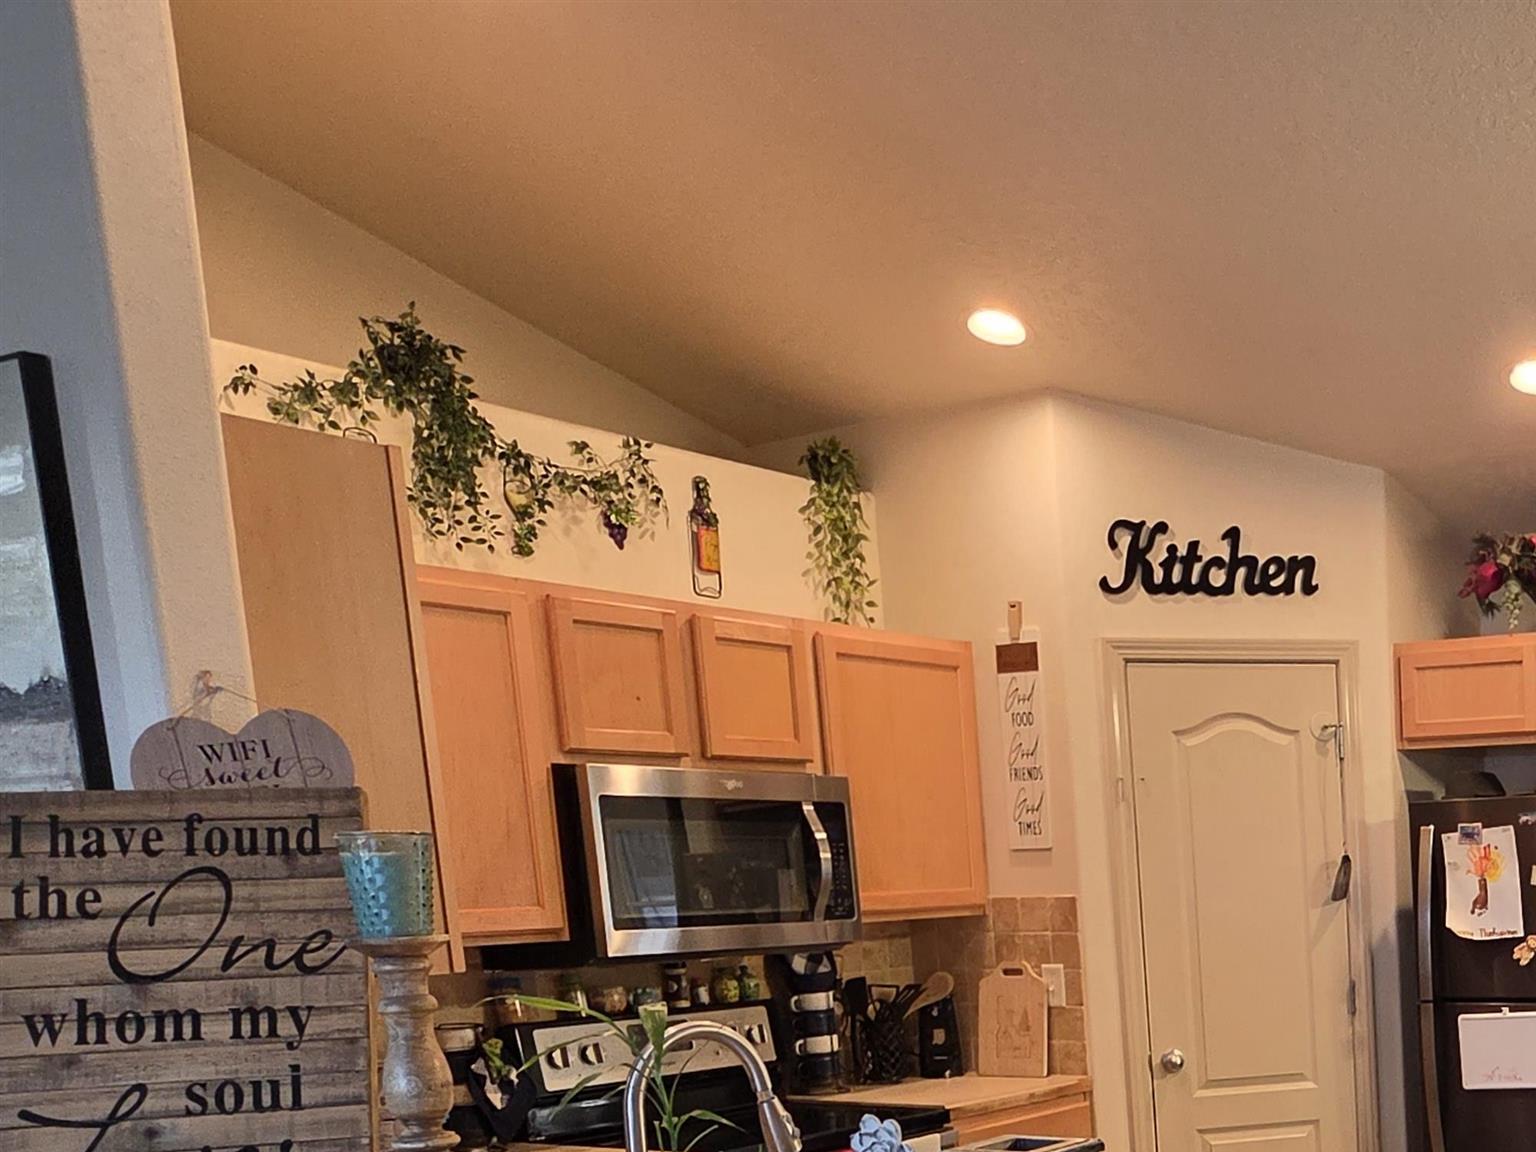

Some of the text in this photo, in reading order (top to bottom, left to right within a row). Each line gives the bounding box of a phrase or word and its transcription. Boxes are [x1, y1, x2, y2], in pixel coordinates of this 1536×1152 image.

[1099, 519, 1319, 596] Kitchen
[1004, 676, 1036, 713] Good
[1011, 711, 1035, 727] FOOD
[199, 738, 272, 765] WIFI
[1008, 731, 1040, 767] Good
[1009, 764, 1044, 783] FRIENDS
[1013, 787, 1045, 822] Good
[7, 812, 323, 860] I have found
[1018, 819, 1043, 837] TIMES
[11, 865, 349, 984] the One
[22, 997, 315, 1050] whom my
[185, 1063, 304, 1116] soul
